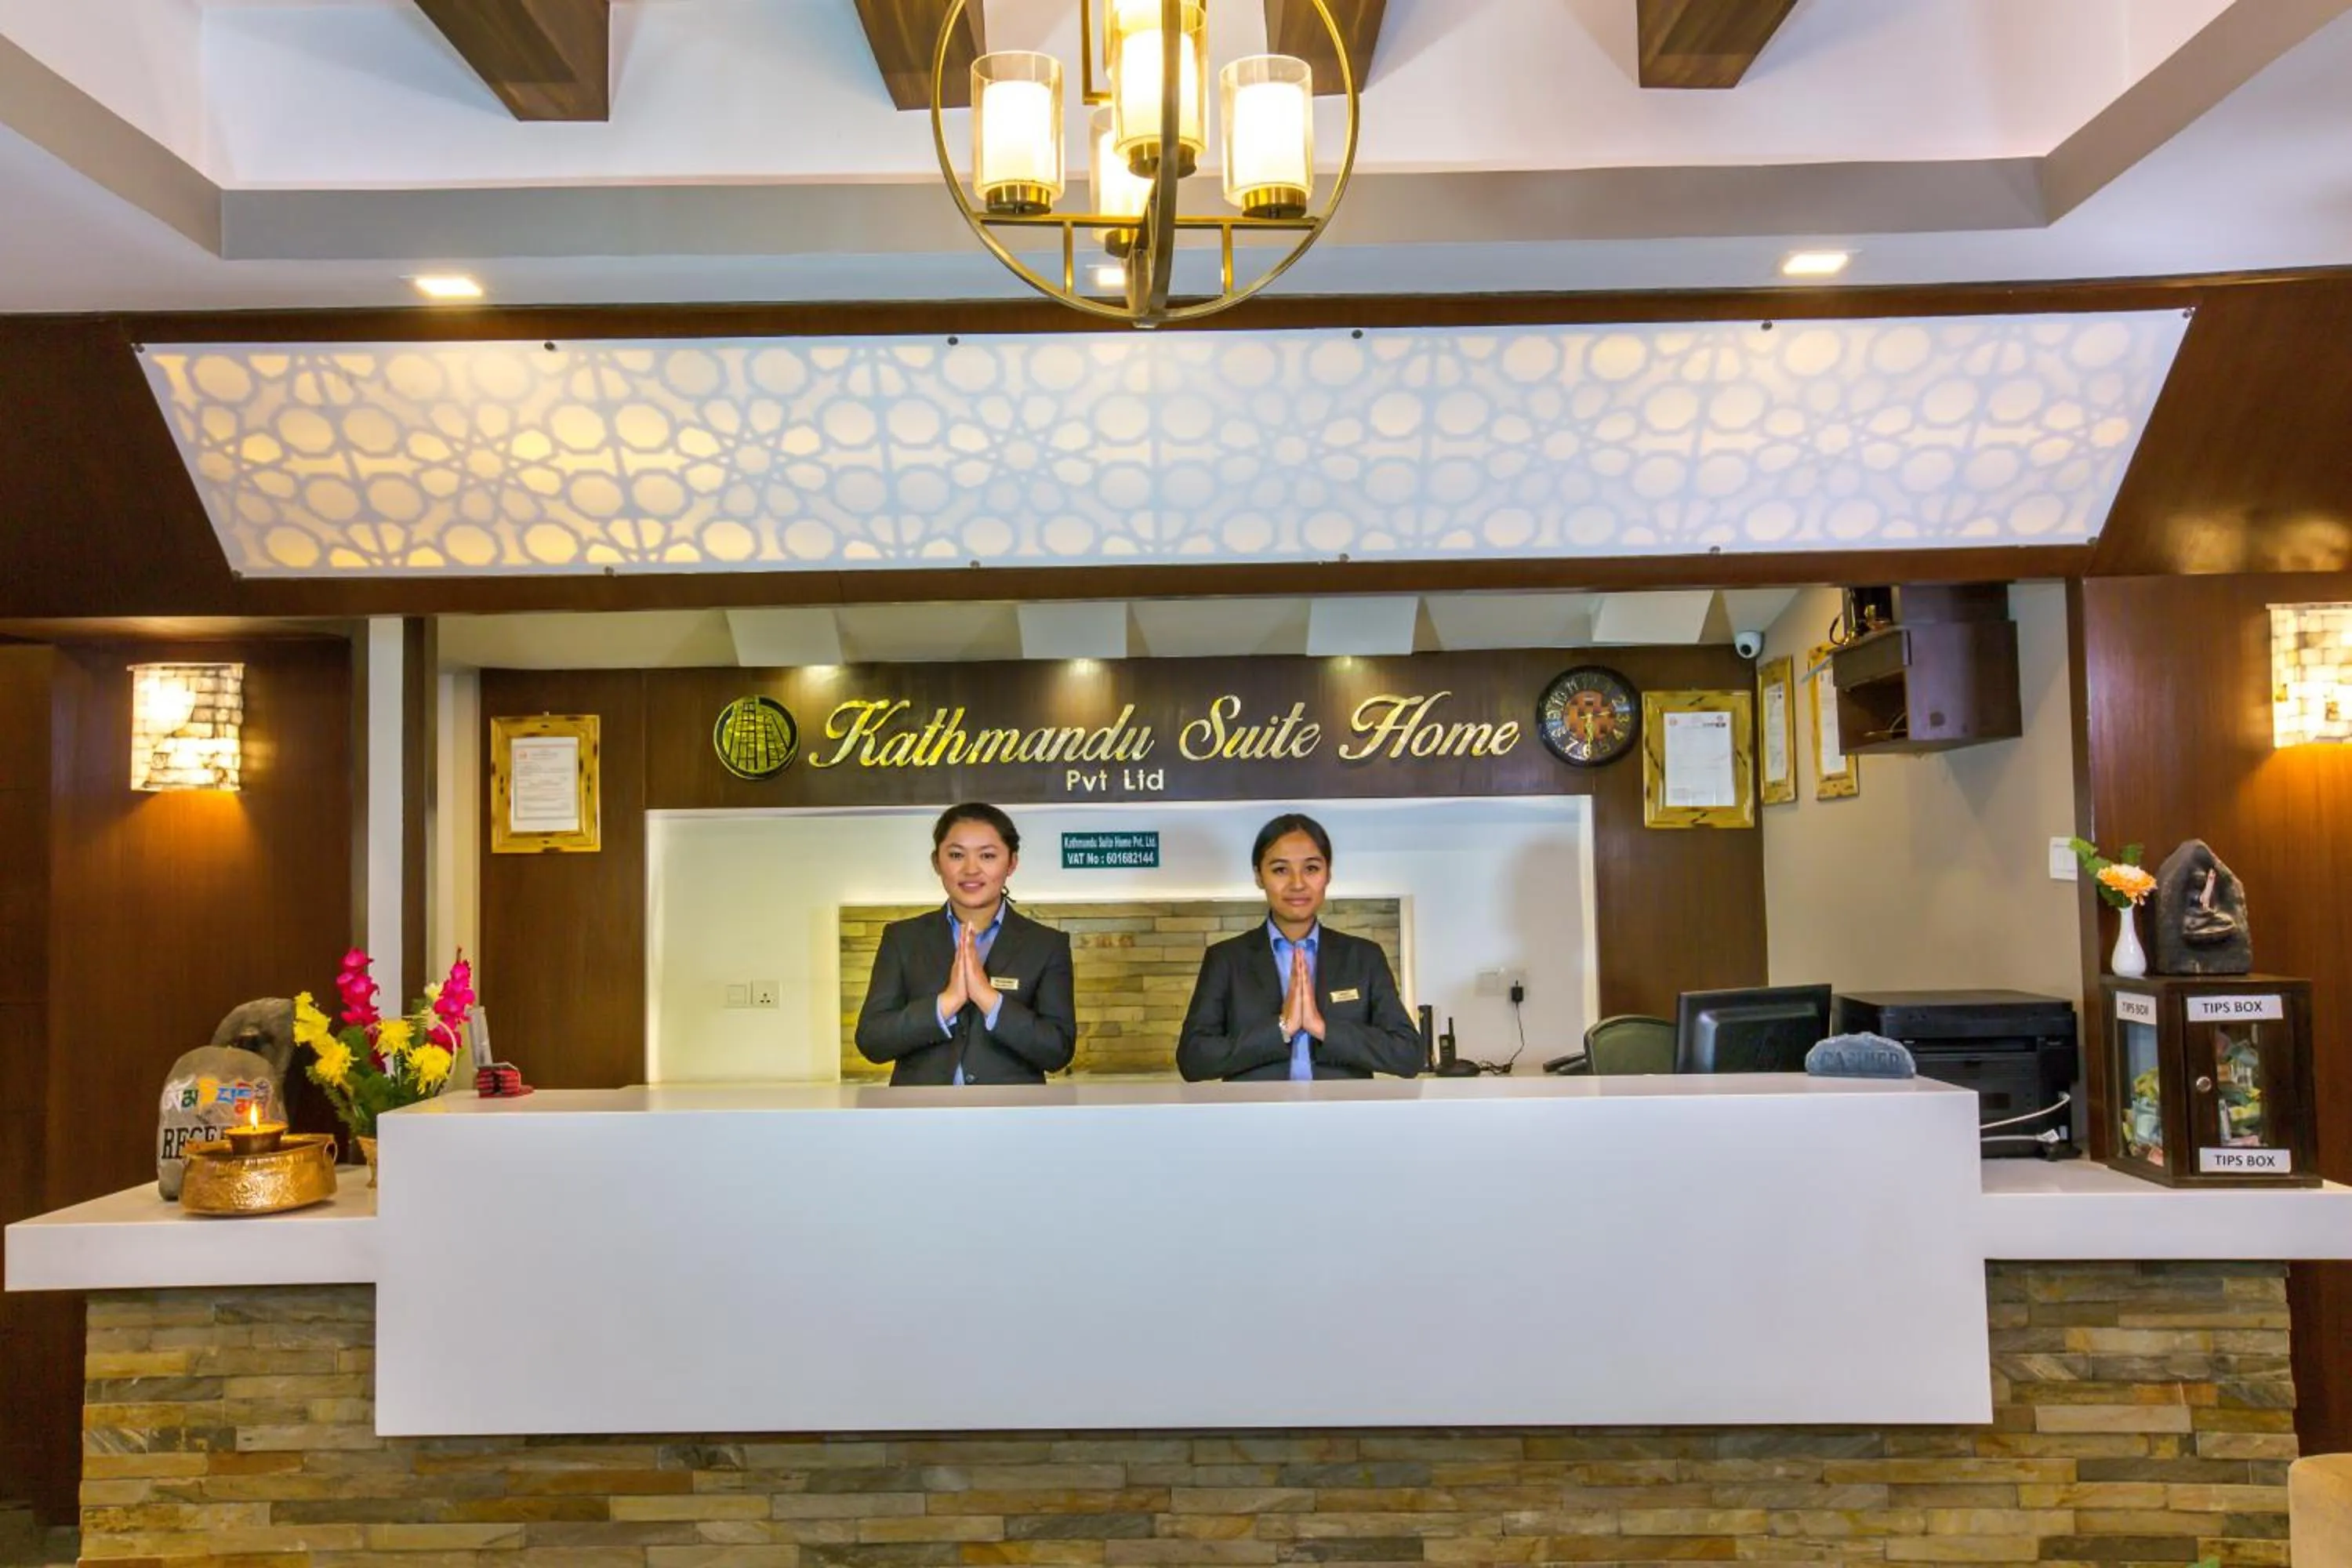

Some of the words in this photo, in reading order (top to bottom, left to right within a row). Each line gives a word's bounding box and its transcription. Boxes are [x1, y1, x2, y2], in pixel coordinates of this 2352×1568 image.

[808, 699, 1155, 768] Kathmandu
[1178, 695, 1321, 760] Suite
[1338, 691, 1520, 760] Home
[1565, 736, 1579, 753] 7
[1067, 769, 1107, 792] Pvt
[1123, 769, 1164, 790] Ltd
[1067, 852, 1083, 865] VAT
[1106, 851, 1154, 864] 601682144
[2122, 1000, 2135, 1014] TIPS
[2201, 1001, 2230, 1014] TIPS
[2234, 1000, 2263, 1013] BOX
[2215, 1155, 2243, 1167] TIPS
[2246, 1155, 2276, 1167] BOX
